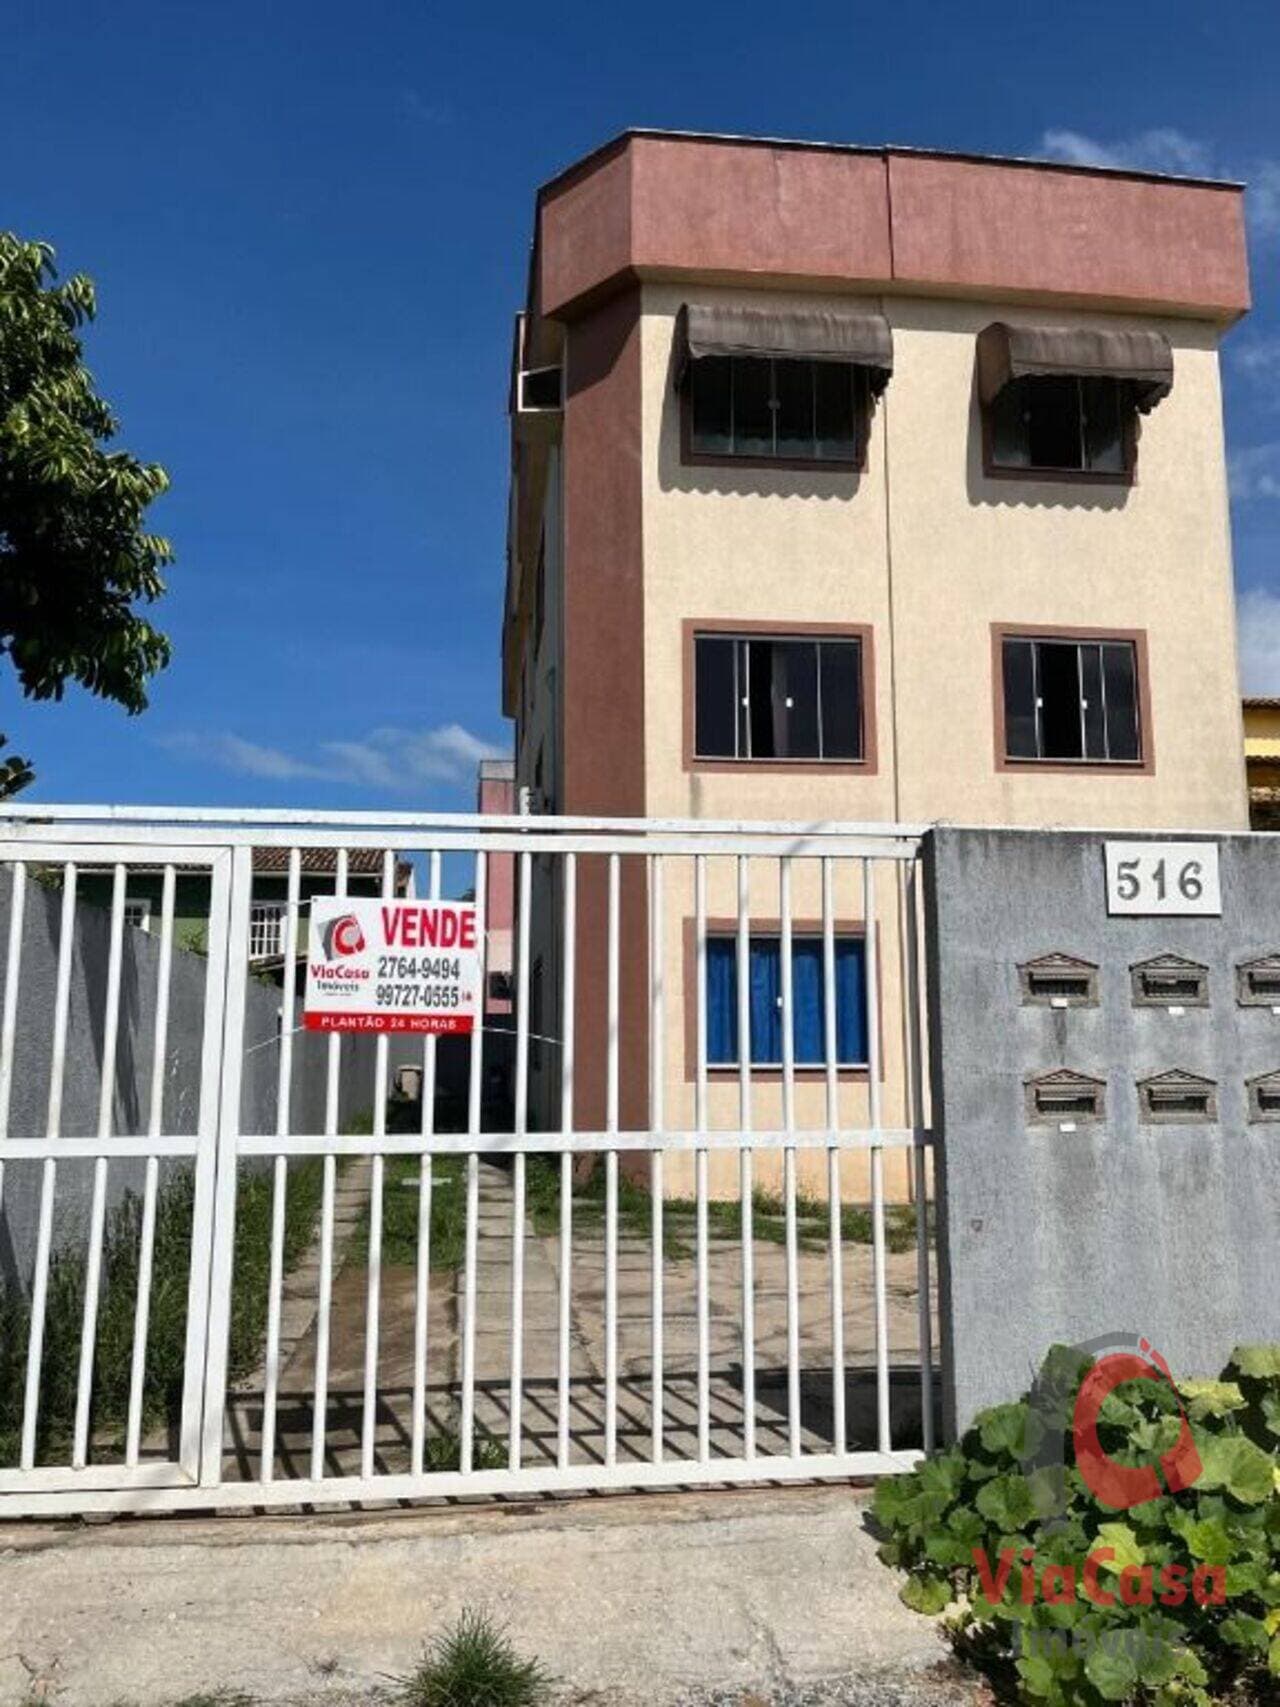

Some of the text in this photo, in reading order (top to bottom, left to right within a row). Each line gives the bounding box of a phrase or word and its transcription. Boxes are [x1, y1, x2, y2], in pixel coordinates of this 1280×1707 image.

[1116, 858, 1203, 901] 516
[381, 907, 476, 948] VENDE
[311, 964, 370, 979] ViaCasa
[378, 956, 460, 980] 2764-9494
[376, 984, 459, 1007] 99727-0555
[321, 1015, 384, 1028] PLANTÃO
[390, 1018, 406, 1028] 24
